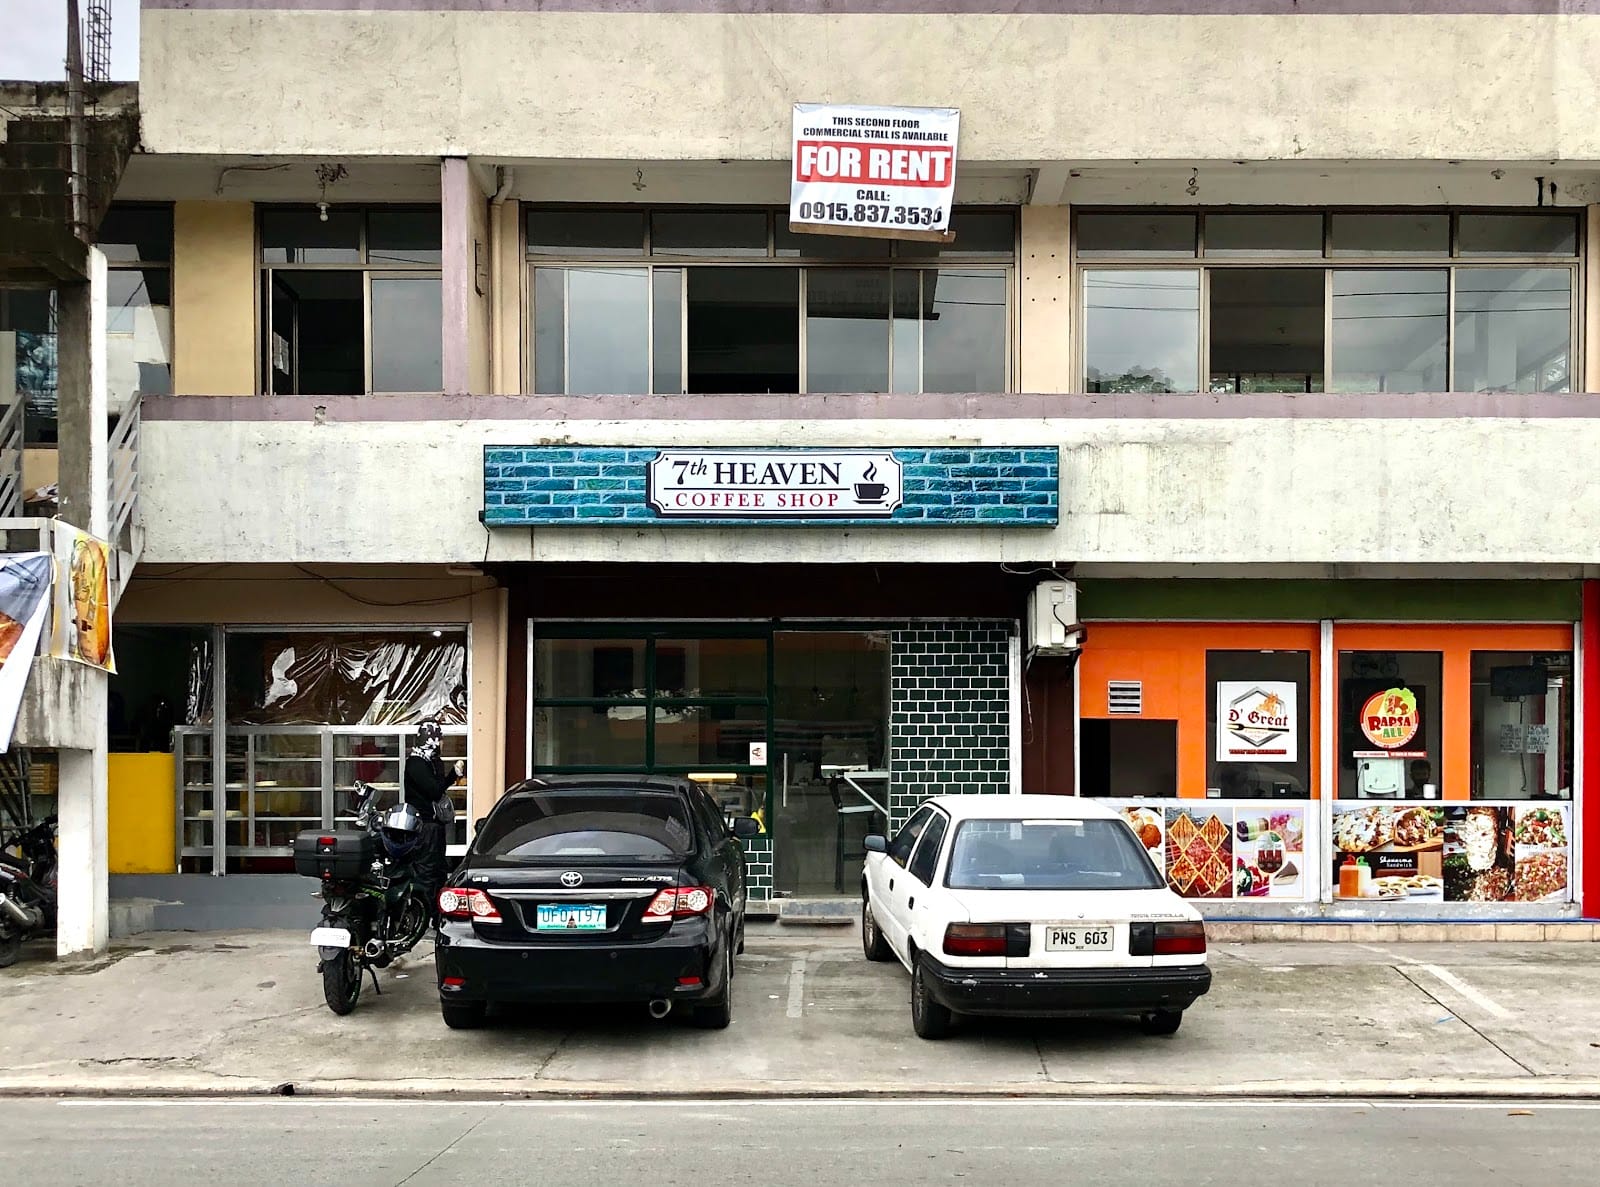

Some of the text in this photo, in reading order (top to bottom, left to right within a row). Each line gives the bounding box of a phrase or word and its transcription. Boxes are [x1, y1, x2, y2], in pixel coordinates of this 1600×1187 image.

[832, 116, 920, 129] THIS SECOND FLOOR
[803, 127, 949, 142] COMMERCIAL STALL IS AVAILABLE
[800, 145, 951, 182] FOR RENT
[856, 189, 891, 202] CALL:
[672, 457, 842, 486] 7th HEAVEN
[675, 492, 840, 508] COFFEE SHOP
[1247, 711, 1288, 727] Great
[1367, 715, 1412, 732] RAPSA
[1382, 727, 1404, 738] ALL
[1052, 931, 1108, 945] PNS 603
